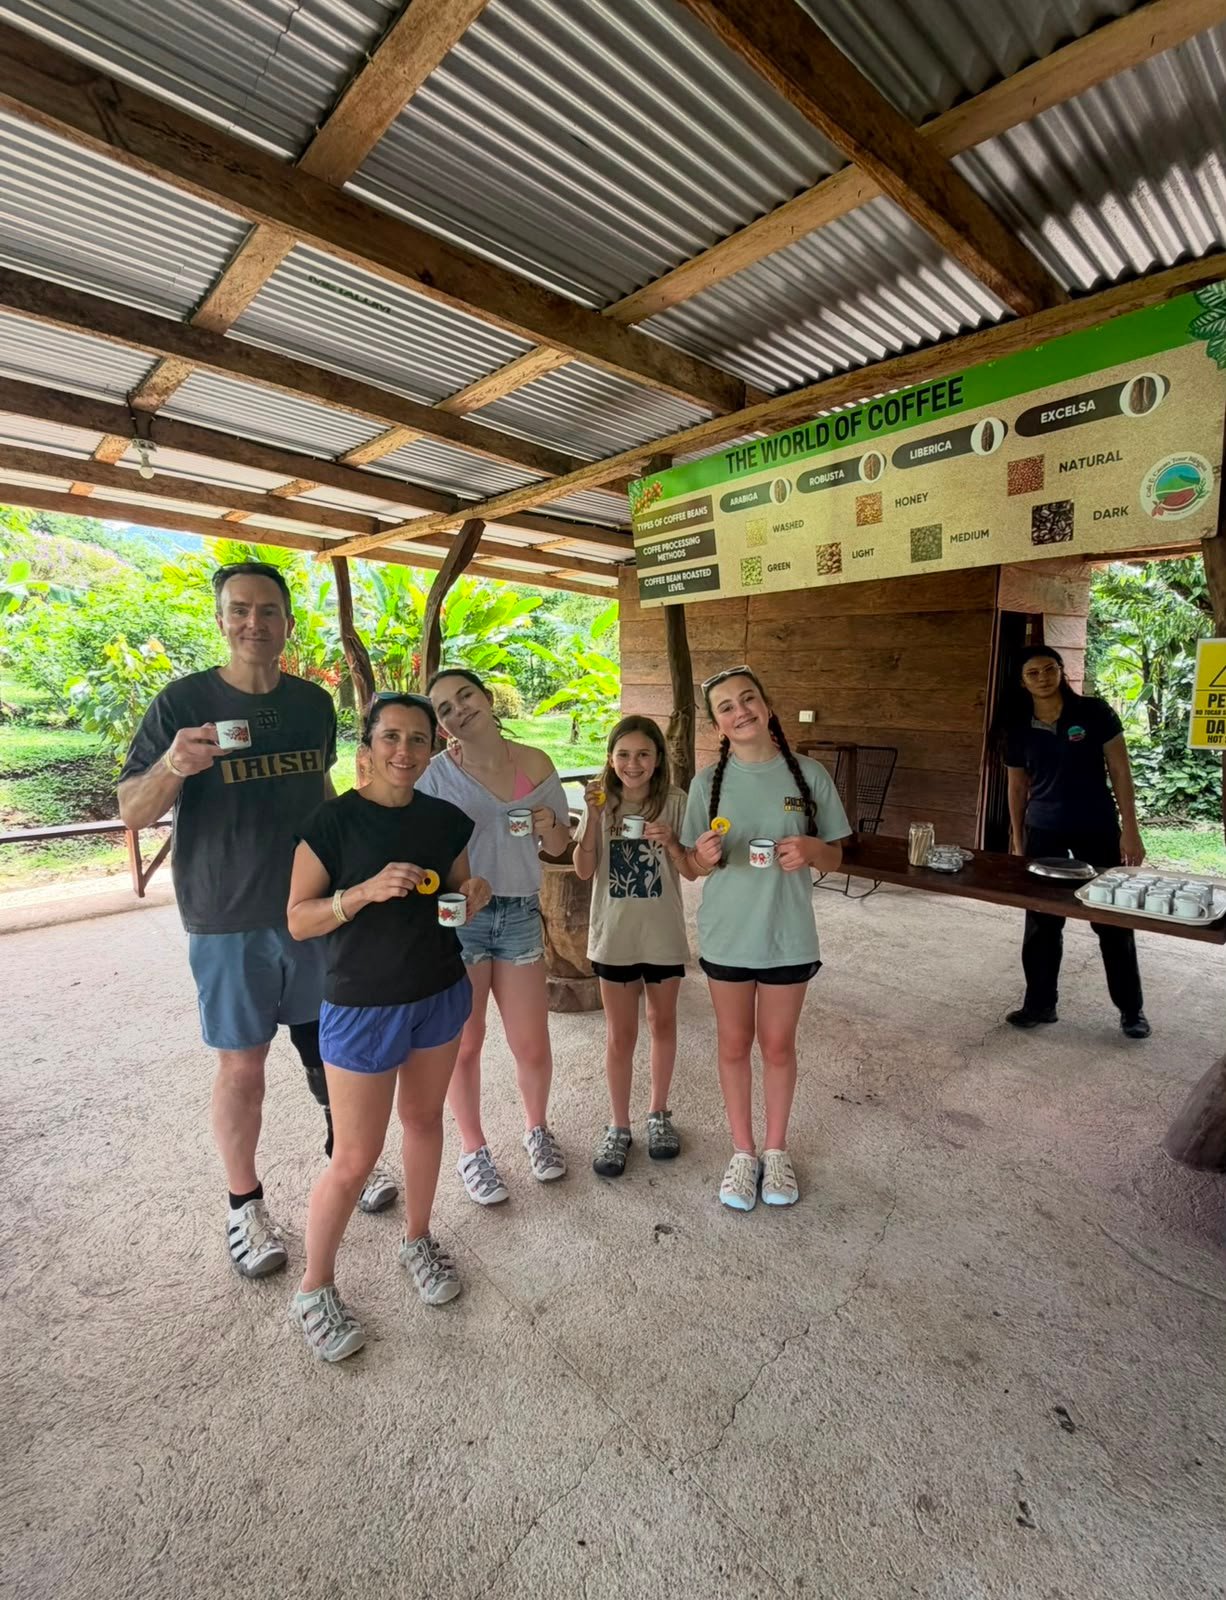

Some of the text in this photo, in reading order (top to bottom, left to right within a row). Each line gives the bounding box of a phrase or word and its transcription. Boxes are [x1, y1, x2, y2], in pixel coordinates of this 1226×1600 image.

[1040, 399, 1096, 424] EXCELSA
[725, 376, 964, 475] THE WORLD OF COFFEE
[909, 440, 952, 460] LIBERICA
[1058, 449, 1123, 474] NATURAL
[809, 469, 846, 486] ROBUSTA
[894, 492, 929, 508] HONEY
[637, 506, 708, 532] TYPES OF COFFEE BEANS
[1093, 505, 1129, 521] DARK
[772, 519, 805, 533] WASHED
[661, 536, 701, 552] PROCESSING
[950, 529, 990, 544] MEDIUM
[657, 549, 686, 562] METHODS
[851, 547, 875, 559] LIGHT
[767, 561, 791, 573] GREEN
[644, 568, 712, 587] COFFEE BEAN ROASTED
[667, 583, 685, 593] LEVEL
[1207, 735, 1223, 744] HOT
[230, 752, 319, 781] IRISH
